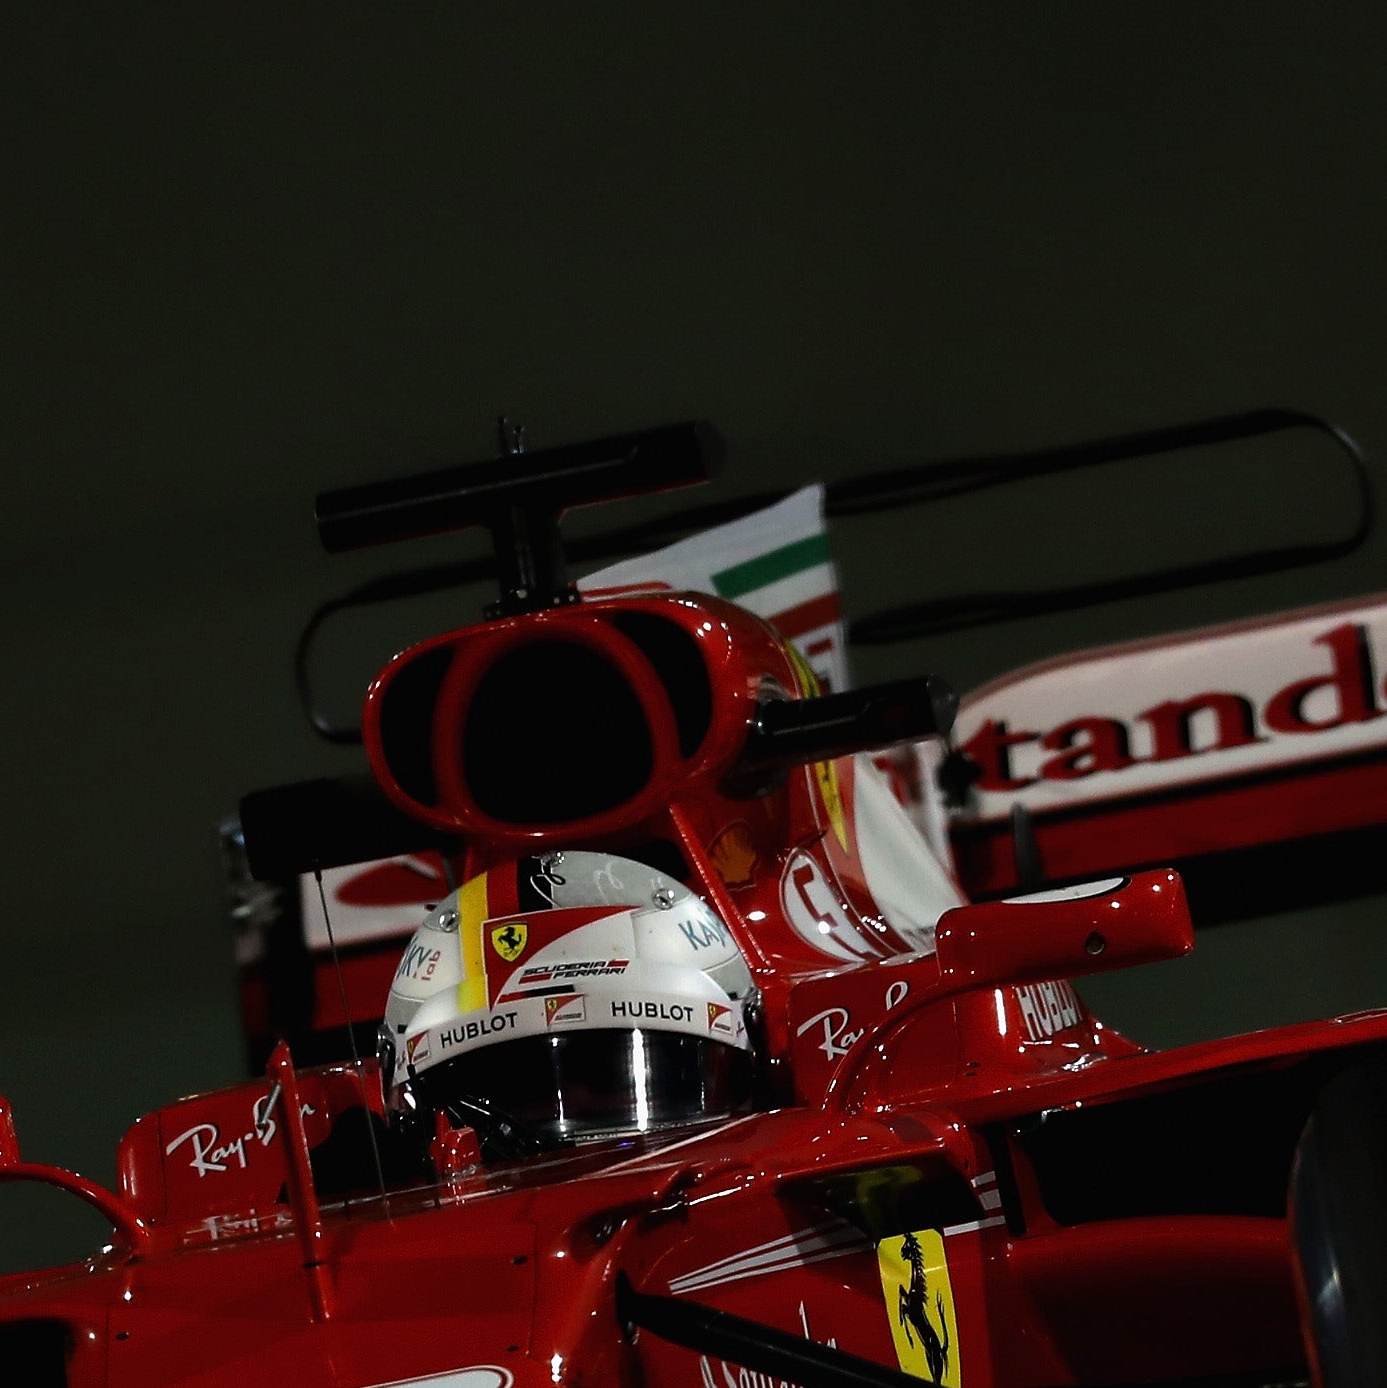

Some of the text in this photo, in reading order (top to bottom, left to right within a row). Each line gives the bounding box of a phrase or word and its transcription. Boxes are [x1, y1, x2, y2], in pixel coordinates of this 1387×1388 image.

[523, 961, 607, 977] SCUDERIA
[552, 967, 626, 980] FERRARI
[611, 1001, 694, 1023] HUBLOT
[440, 1012, 518, 1049] HUBLOT
[165, 1083, 316, 1179] Ray-Bn
